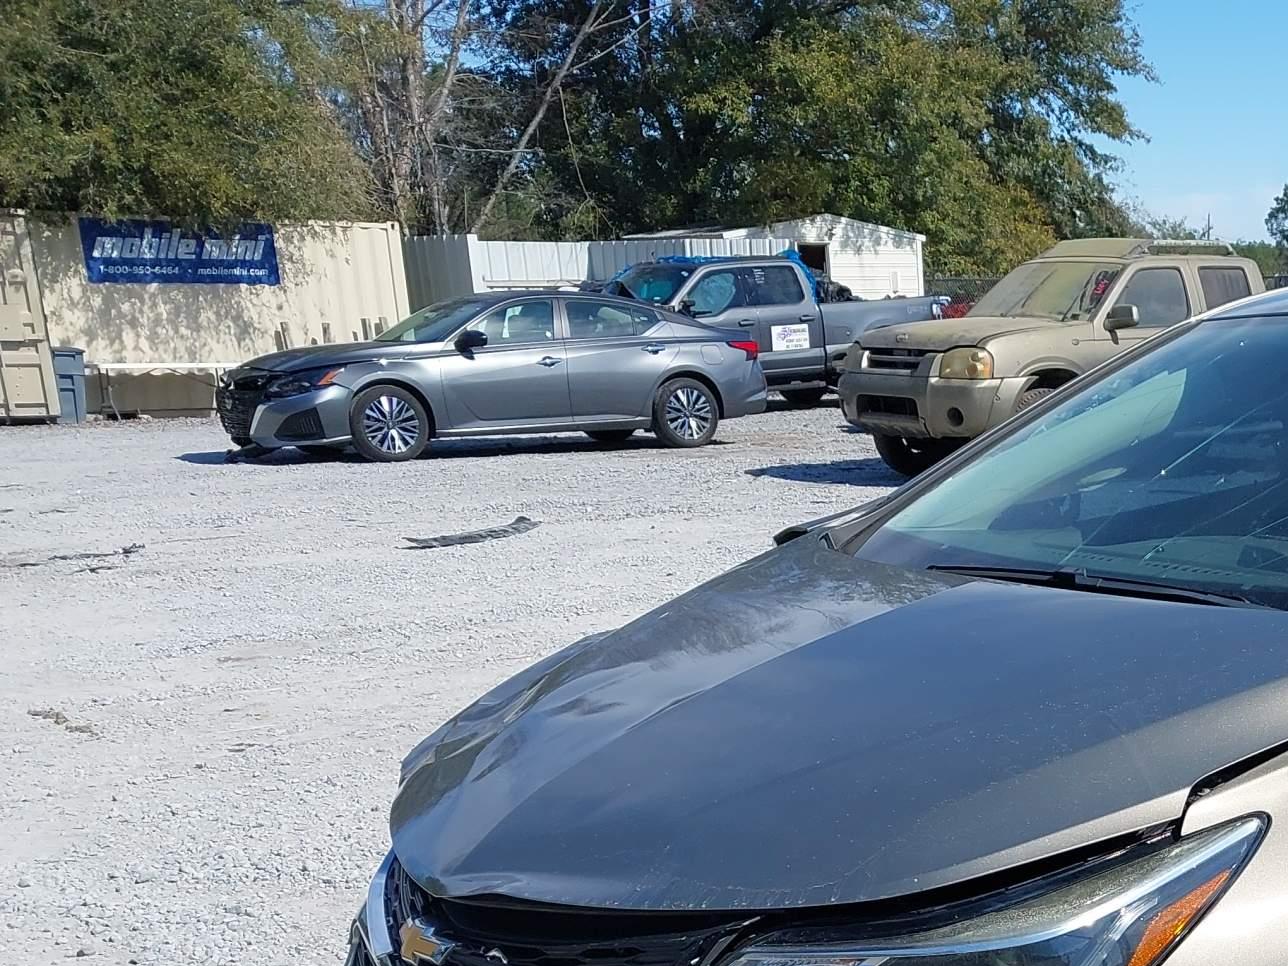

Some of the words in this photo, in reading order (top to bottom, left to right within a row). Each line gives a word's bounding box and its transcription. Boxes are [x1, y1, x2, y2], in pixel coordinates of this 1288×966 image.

[92, 227, 197, 259] mobile
[202, 234, 266, 261] mini
[197, 266, 269, 276] mobilemini.com
